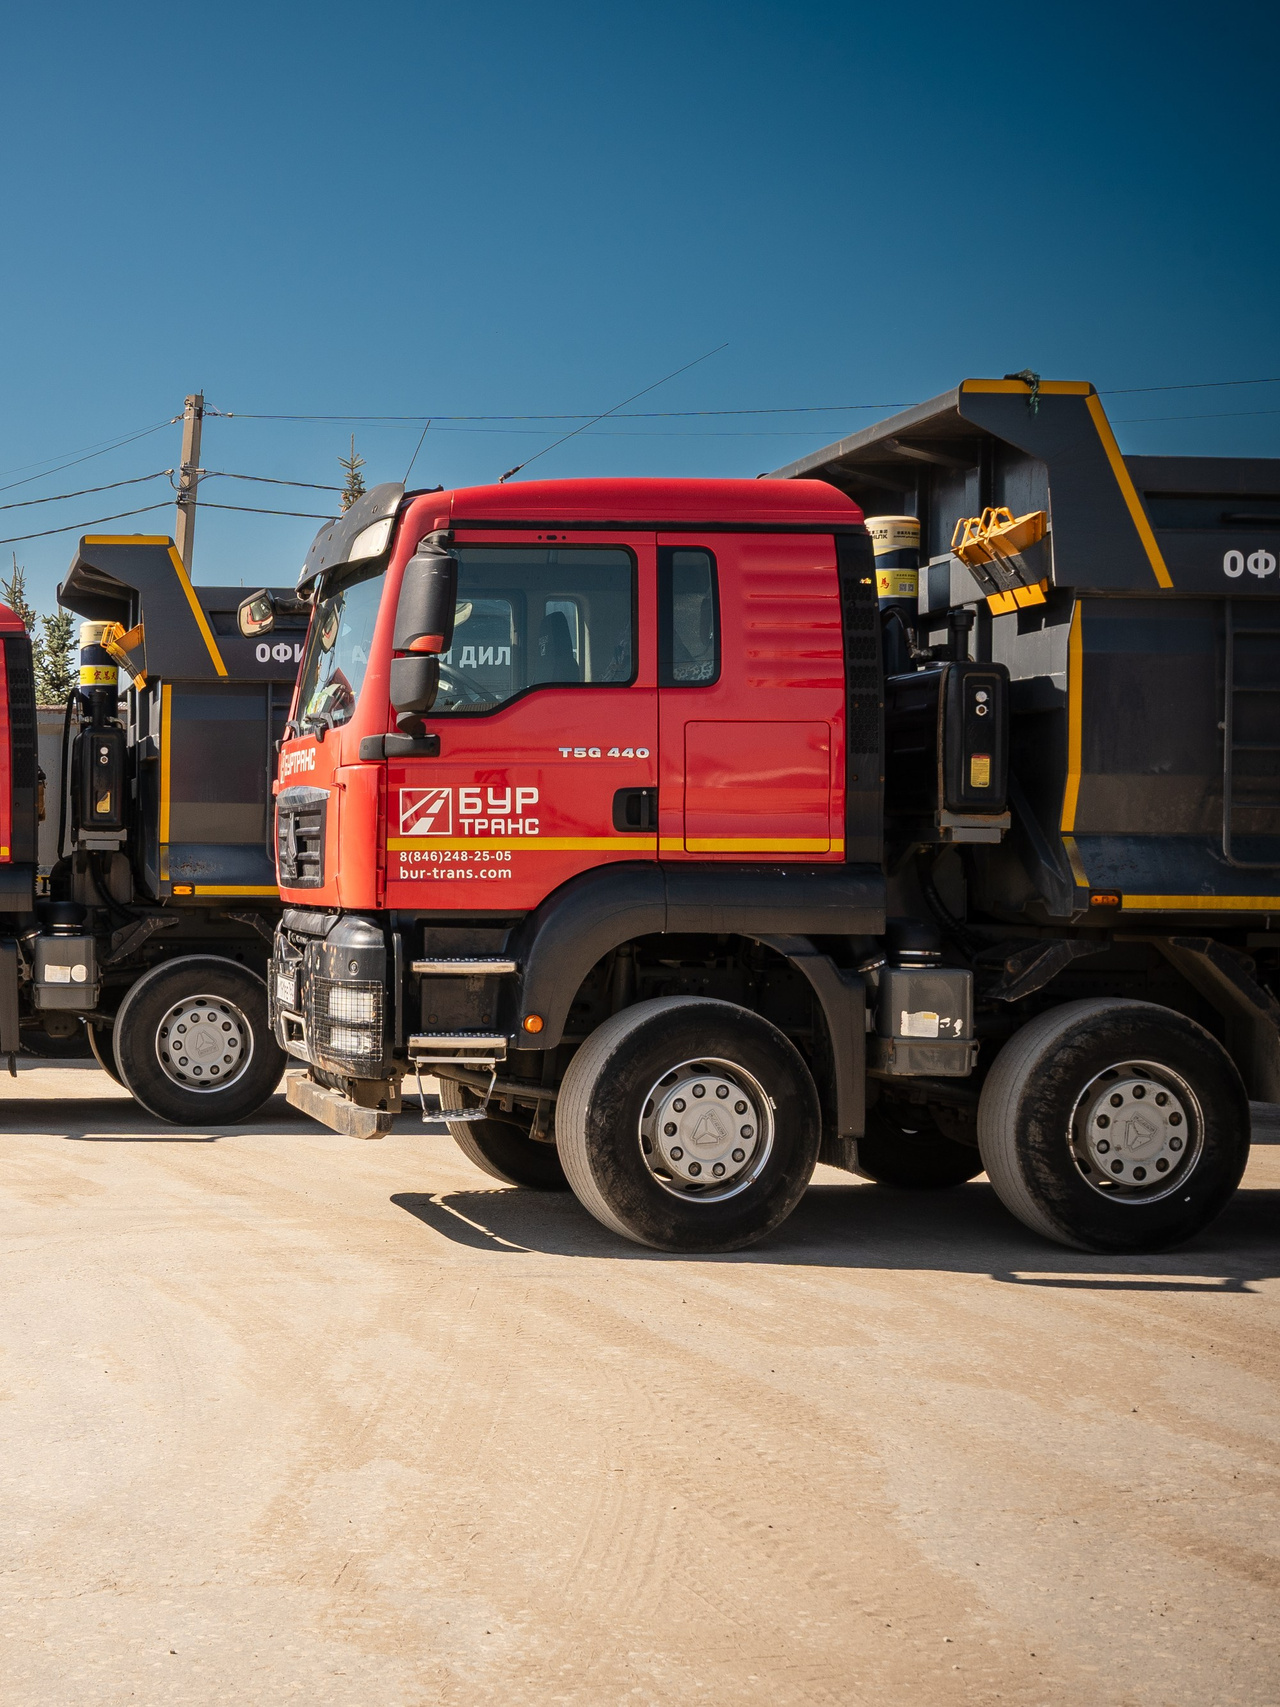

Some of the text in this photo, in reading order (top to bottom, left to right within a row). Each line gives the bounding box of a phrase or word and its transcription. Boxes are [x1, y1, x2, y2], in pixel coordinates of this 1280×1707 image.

[1223, 549, 1280, 579] ОФ
[607, 747, 650, 758] 440
[459, 787, 539, 815] БУР
[459, 818, 540, 835] ТРАНС
[399, 851, 512, 864] 8(846)248-25-05
[399, 867, 512, 879] bur-trans.com
